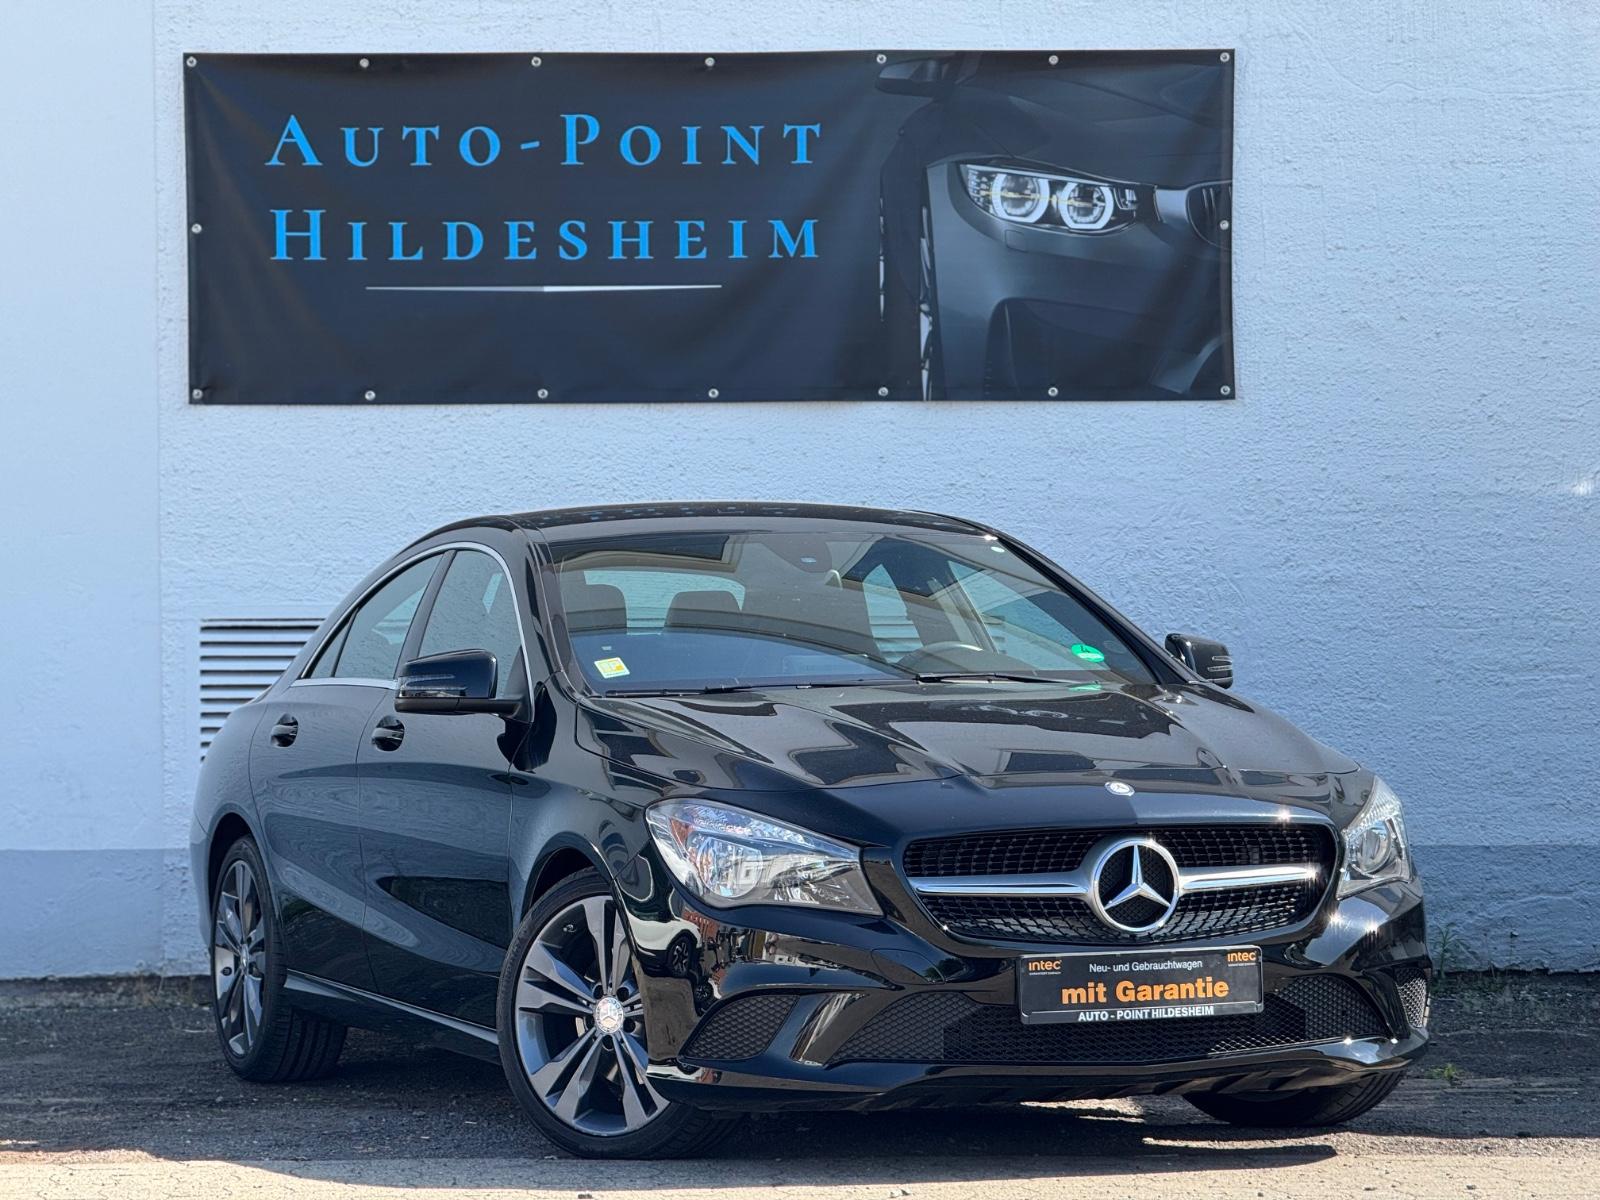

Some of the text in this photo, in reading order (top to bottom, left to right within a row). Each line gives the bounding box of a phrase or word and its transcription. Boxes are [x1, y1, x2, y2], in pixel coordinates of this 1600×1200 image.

[269, 208, 819, 261] HILDESHEIM
[1089, 960, 1203, 973] Neu- und Gebrauchtwagen
[1061, 976, 1230, 1004] mit Garantie
[1078, 1011, 1109, 1022] AUTO
[1116, 1009, 1150, 1020] POINT
[1151, 1005, 1215, 1019] HILDESHEIM
